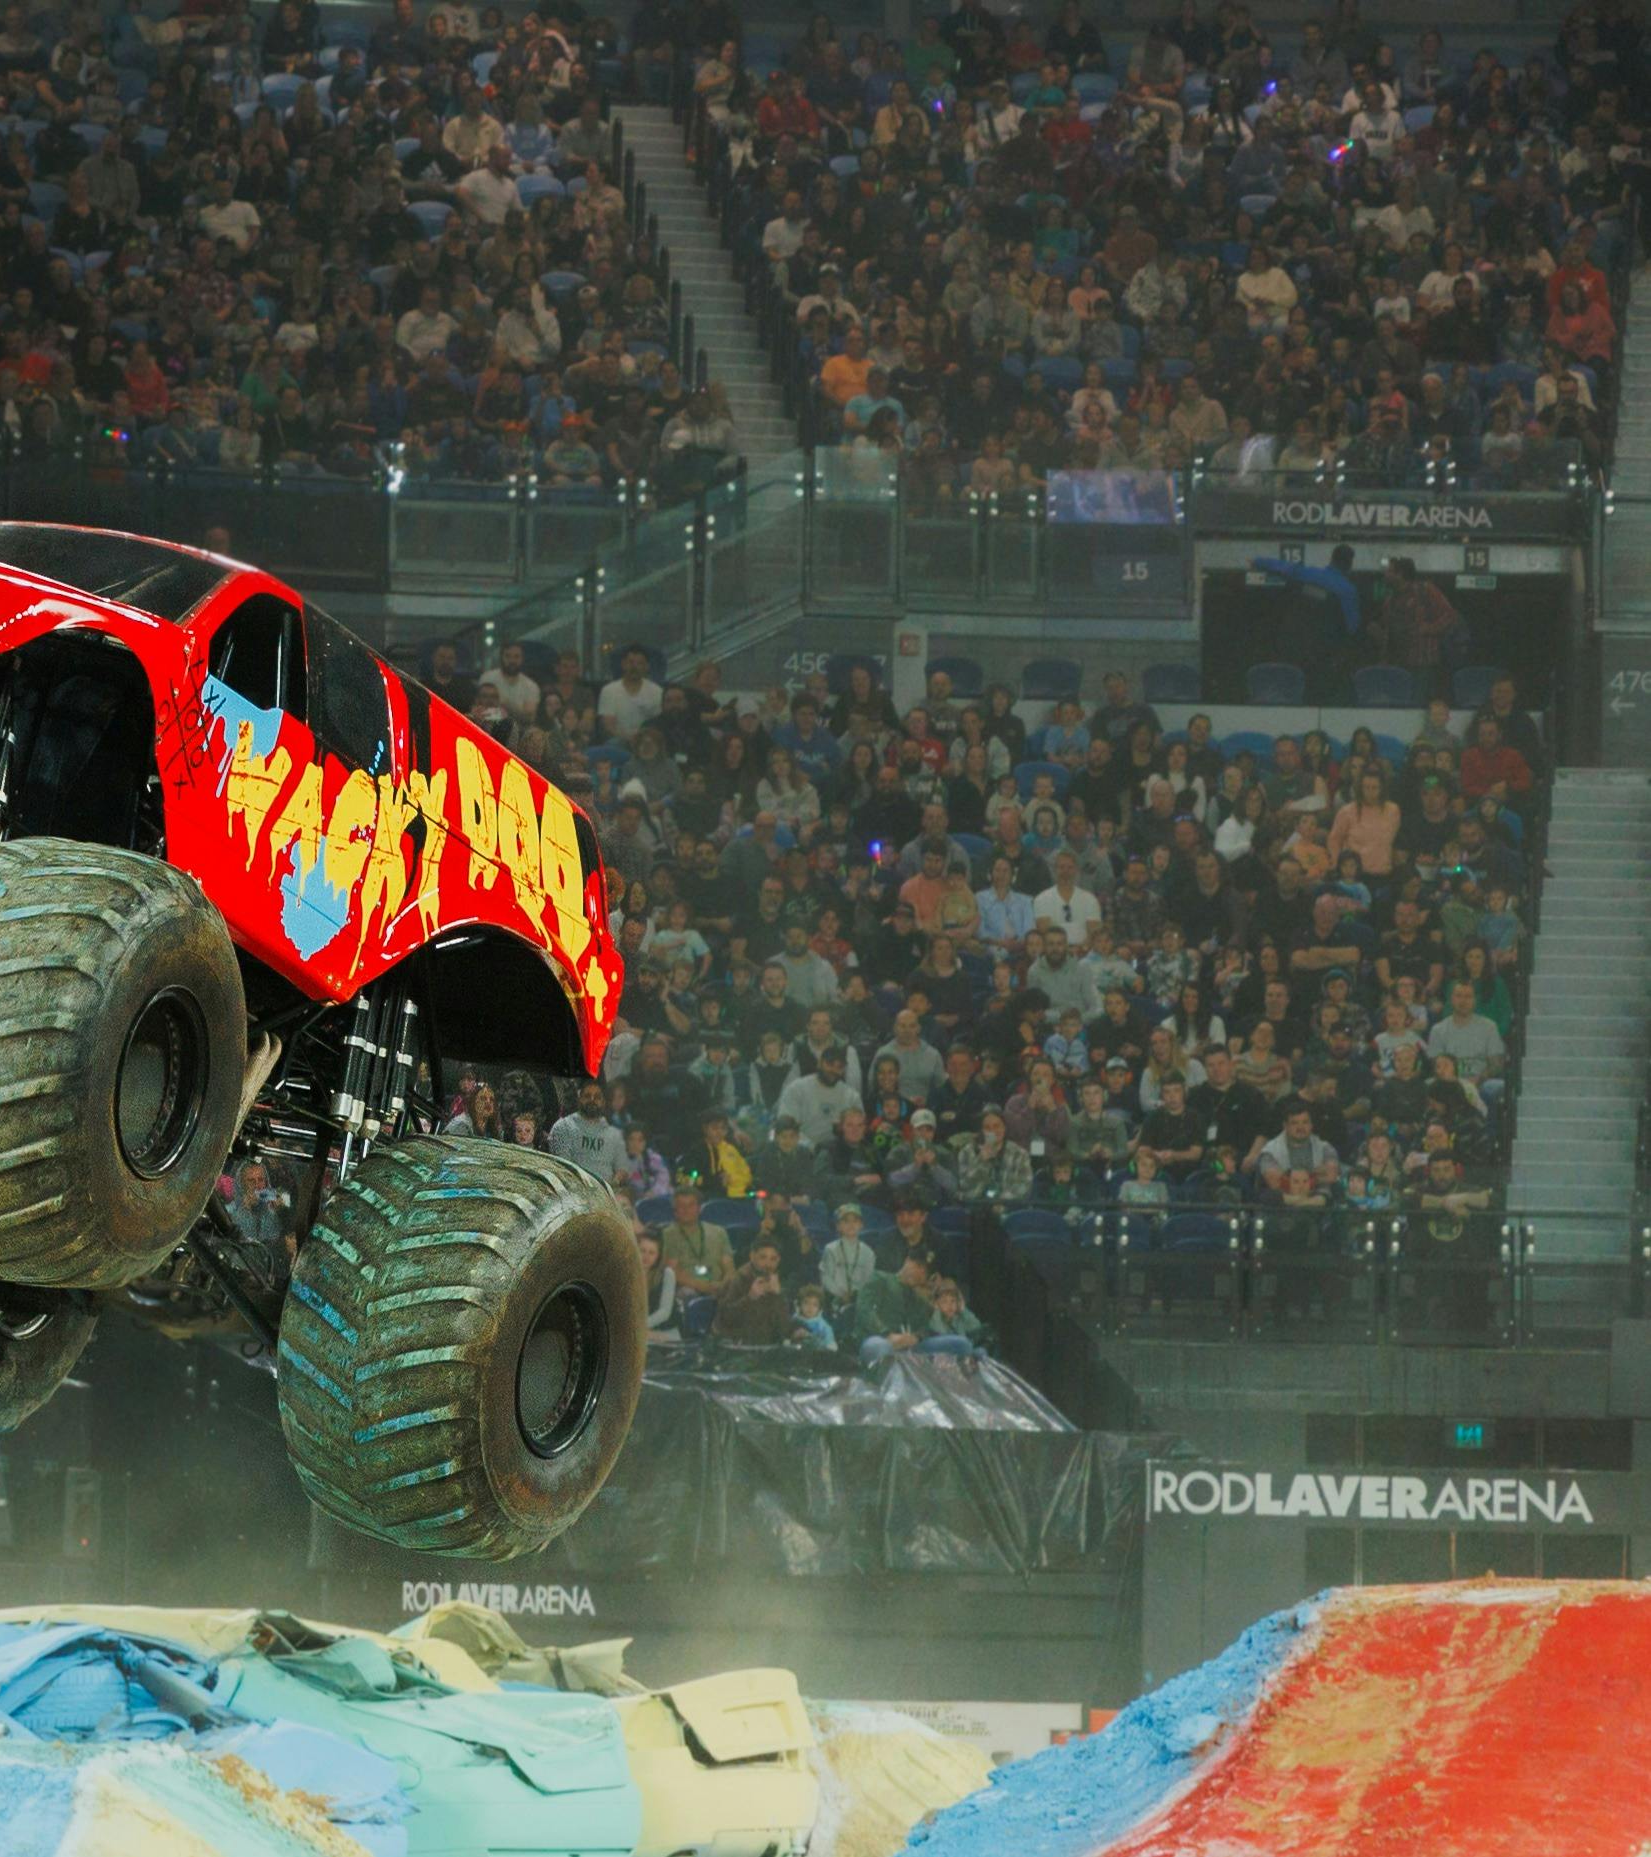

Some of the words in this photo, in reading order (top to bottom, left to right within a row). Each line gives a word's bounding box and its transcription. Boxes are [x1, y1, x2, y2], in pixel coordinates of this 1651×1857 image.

[1467, 551, 1486, 567] 15
[1122, 561, 1149, 581] 15
[226, 719, 448, 965] WACKY
